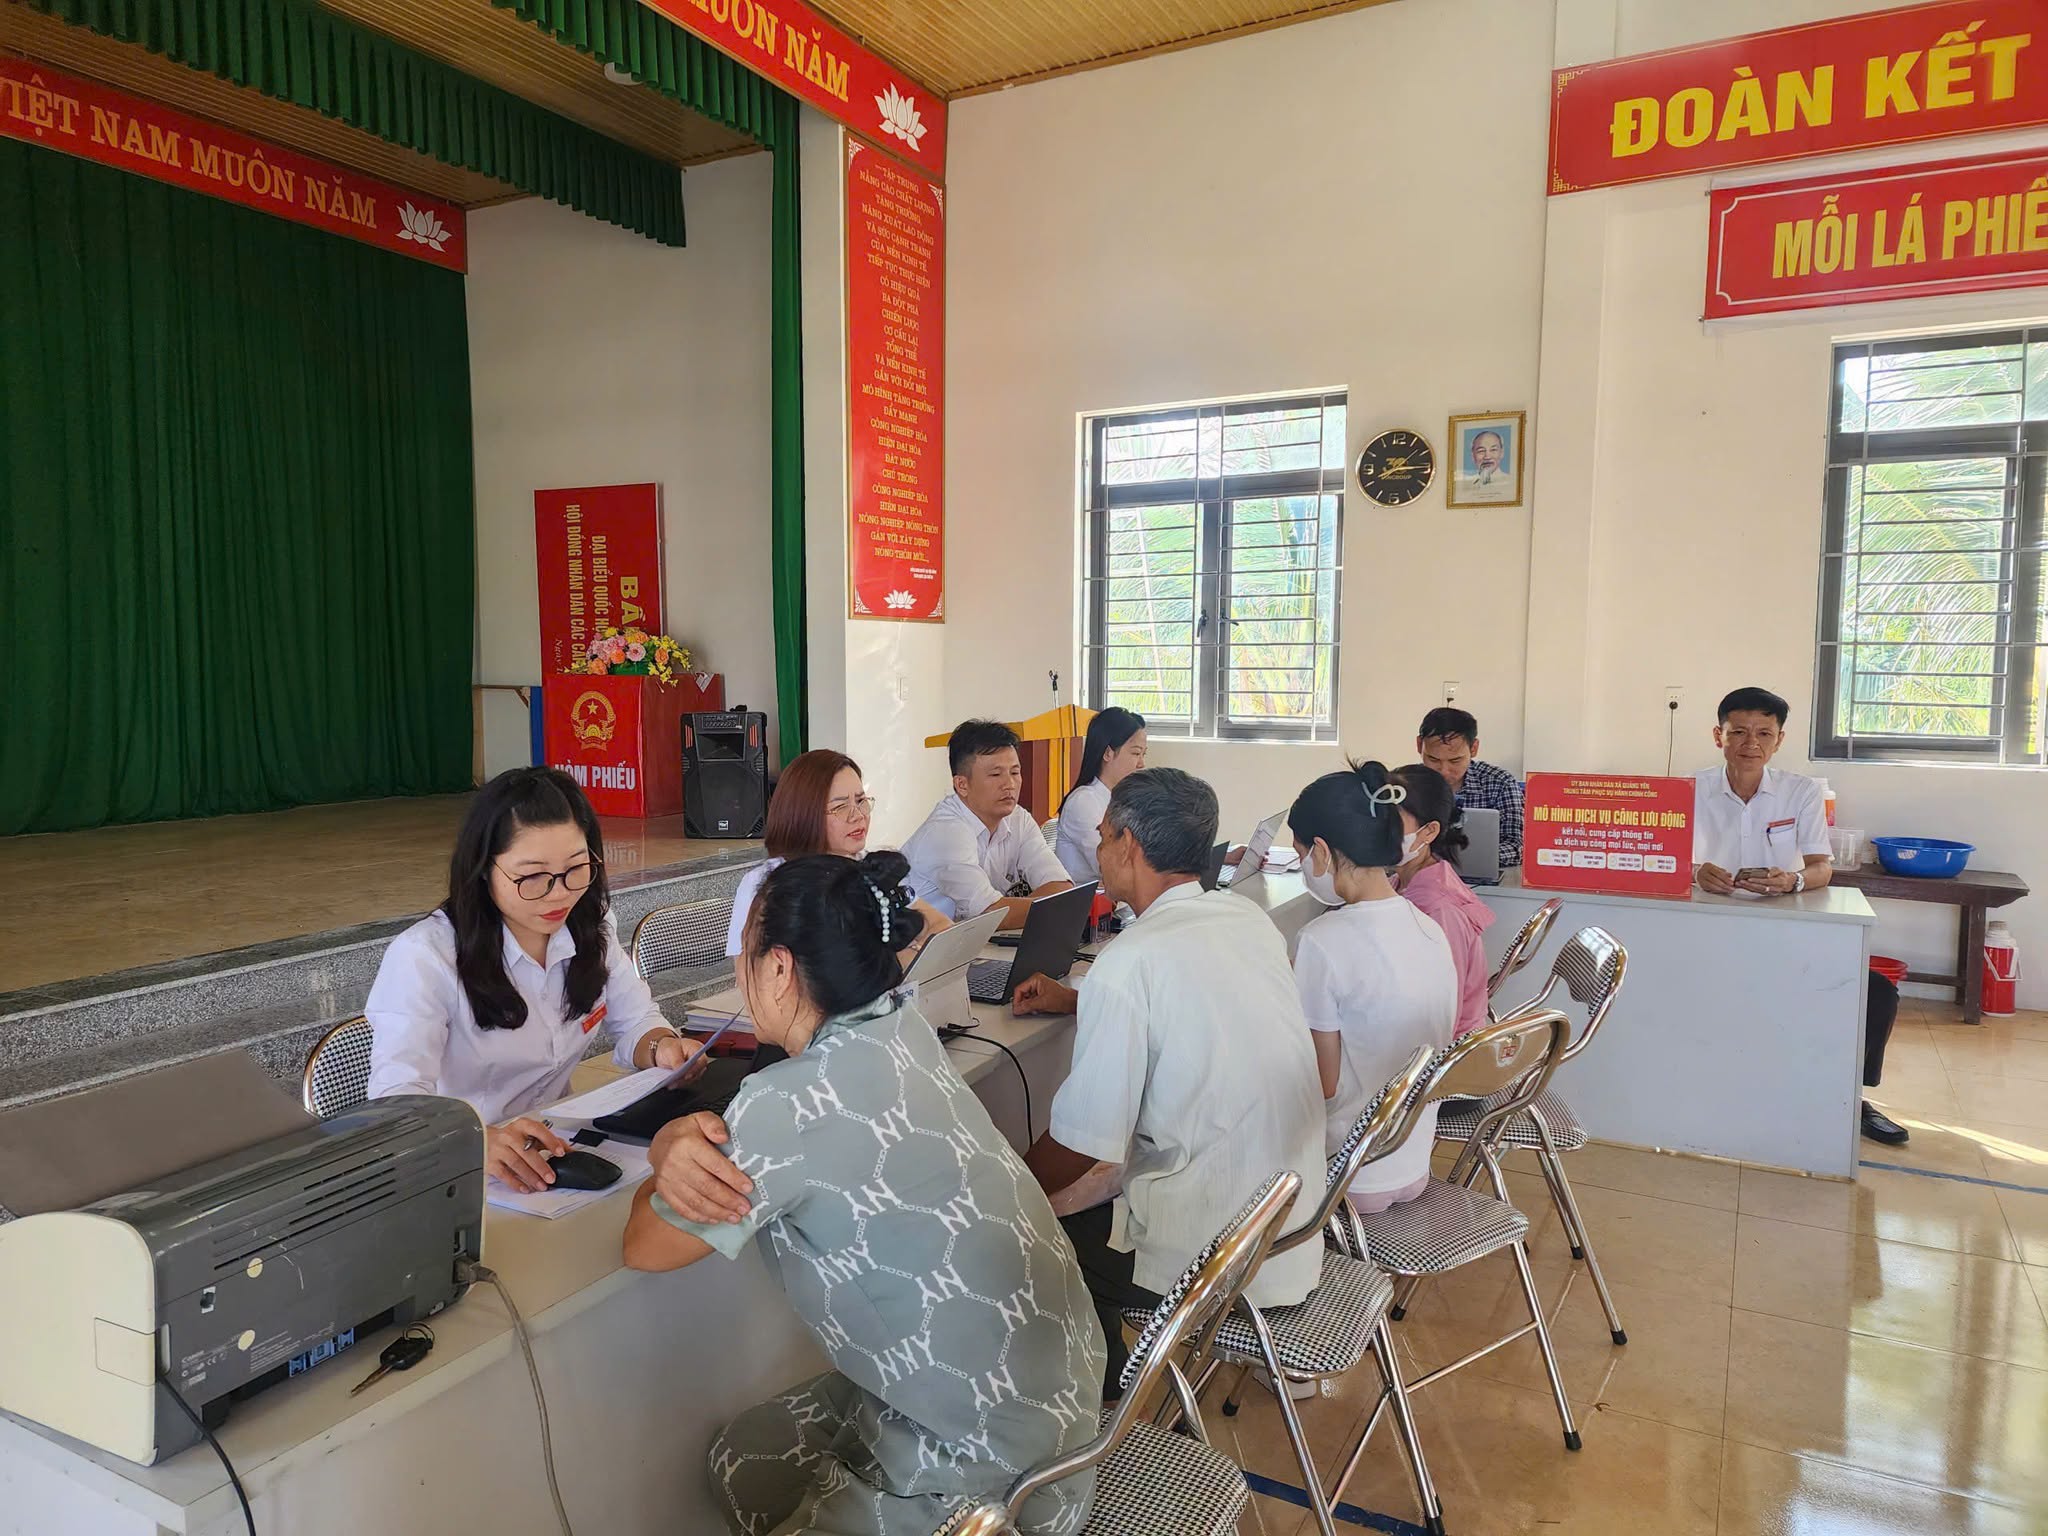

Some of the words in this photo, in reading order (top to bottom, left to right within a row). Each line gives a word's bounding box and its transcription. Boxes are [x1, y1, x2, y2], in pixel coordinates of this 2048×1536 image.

[783, 24, 850, 102] NĂM
[1610, 64, 1834, 158] ĐOÀN
[1865, 19, 2031, 119] KẾT
[90, 104, 182, 169] NAM
[190, 138, 295, 203] MUÔN
[304, 175, 377, 230] NĂM
[1772, 194, 1858, 278] MỖI
[1871, 193, 1927, 268] LÁ
[1392, 433, 1407, 445] 12
[1363, 464, 1374, 475] 9
[564, 504, 583, 523] HỘI
[567, 526, 586, 557] ĐỒNG
[589, 535, 606, 554] ĐẠI
[569, 559, 586, 590] NHÂN
[592, 557, 613, 583] BIỂU
[570, 593, 586, 616] DÂN
[592, 585, 614, 615] QUỐC
[570, 618, 586, 641] CÁC
[592, 618, 610, 633] HỘ
[592, 760, 635, 790] PHIẾU
[1534, 805, 1549, 821] MÔ
[1550, 805, 1573, 823] HÌNH
[1574, 808, 1597, 828] DỊCH
[1600, 810, 1611, 827] VỤ
[1613, 808, 1638, 826] CÔNG
[1641, 811, 1658, 827] LƯU
[1660, 810, 1686, 830] ĐỘNG
[1554, 838, 1563, 846] và
[1564, 838, 1579, 847] dịch
[1608, 840, 1621, 849] mọi
[1637, 842, 1650, 852] mọi
[1589, 829, 1606, 839] cung
[1622, 830, 1642, 840] thông
